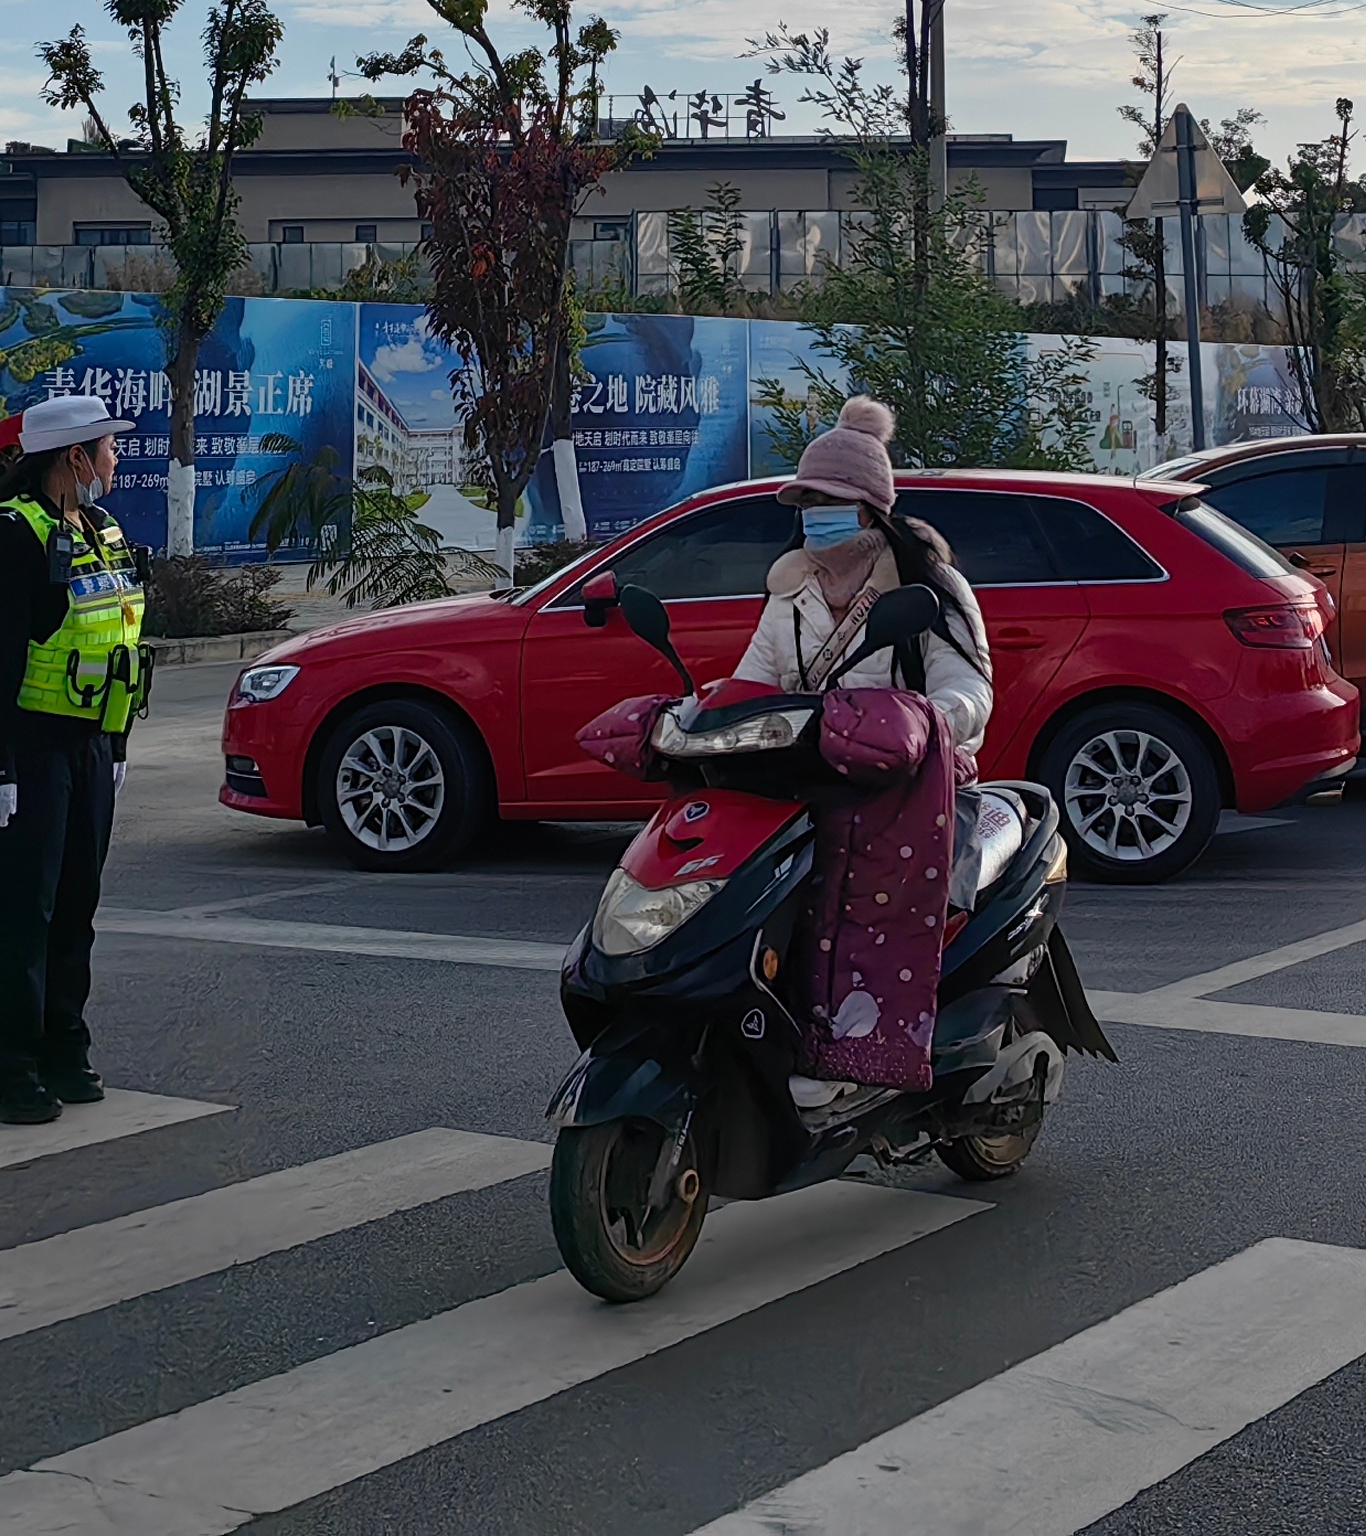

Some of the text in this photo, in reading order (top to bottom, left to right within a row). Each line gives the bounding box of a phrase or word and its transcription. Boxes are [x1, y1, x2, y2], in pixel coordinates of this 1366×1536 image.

[192, 368, 315, 418] 湖景正席
[635, 373, 721, 415] 院藏风雅
